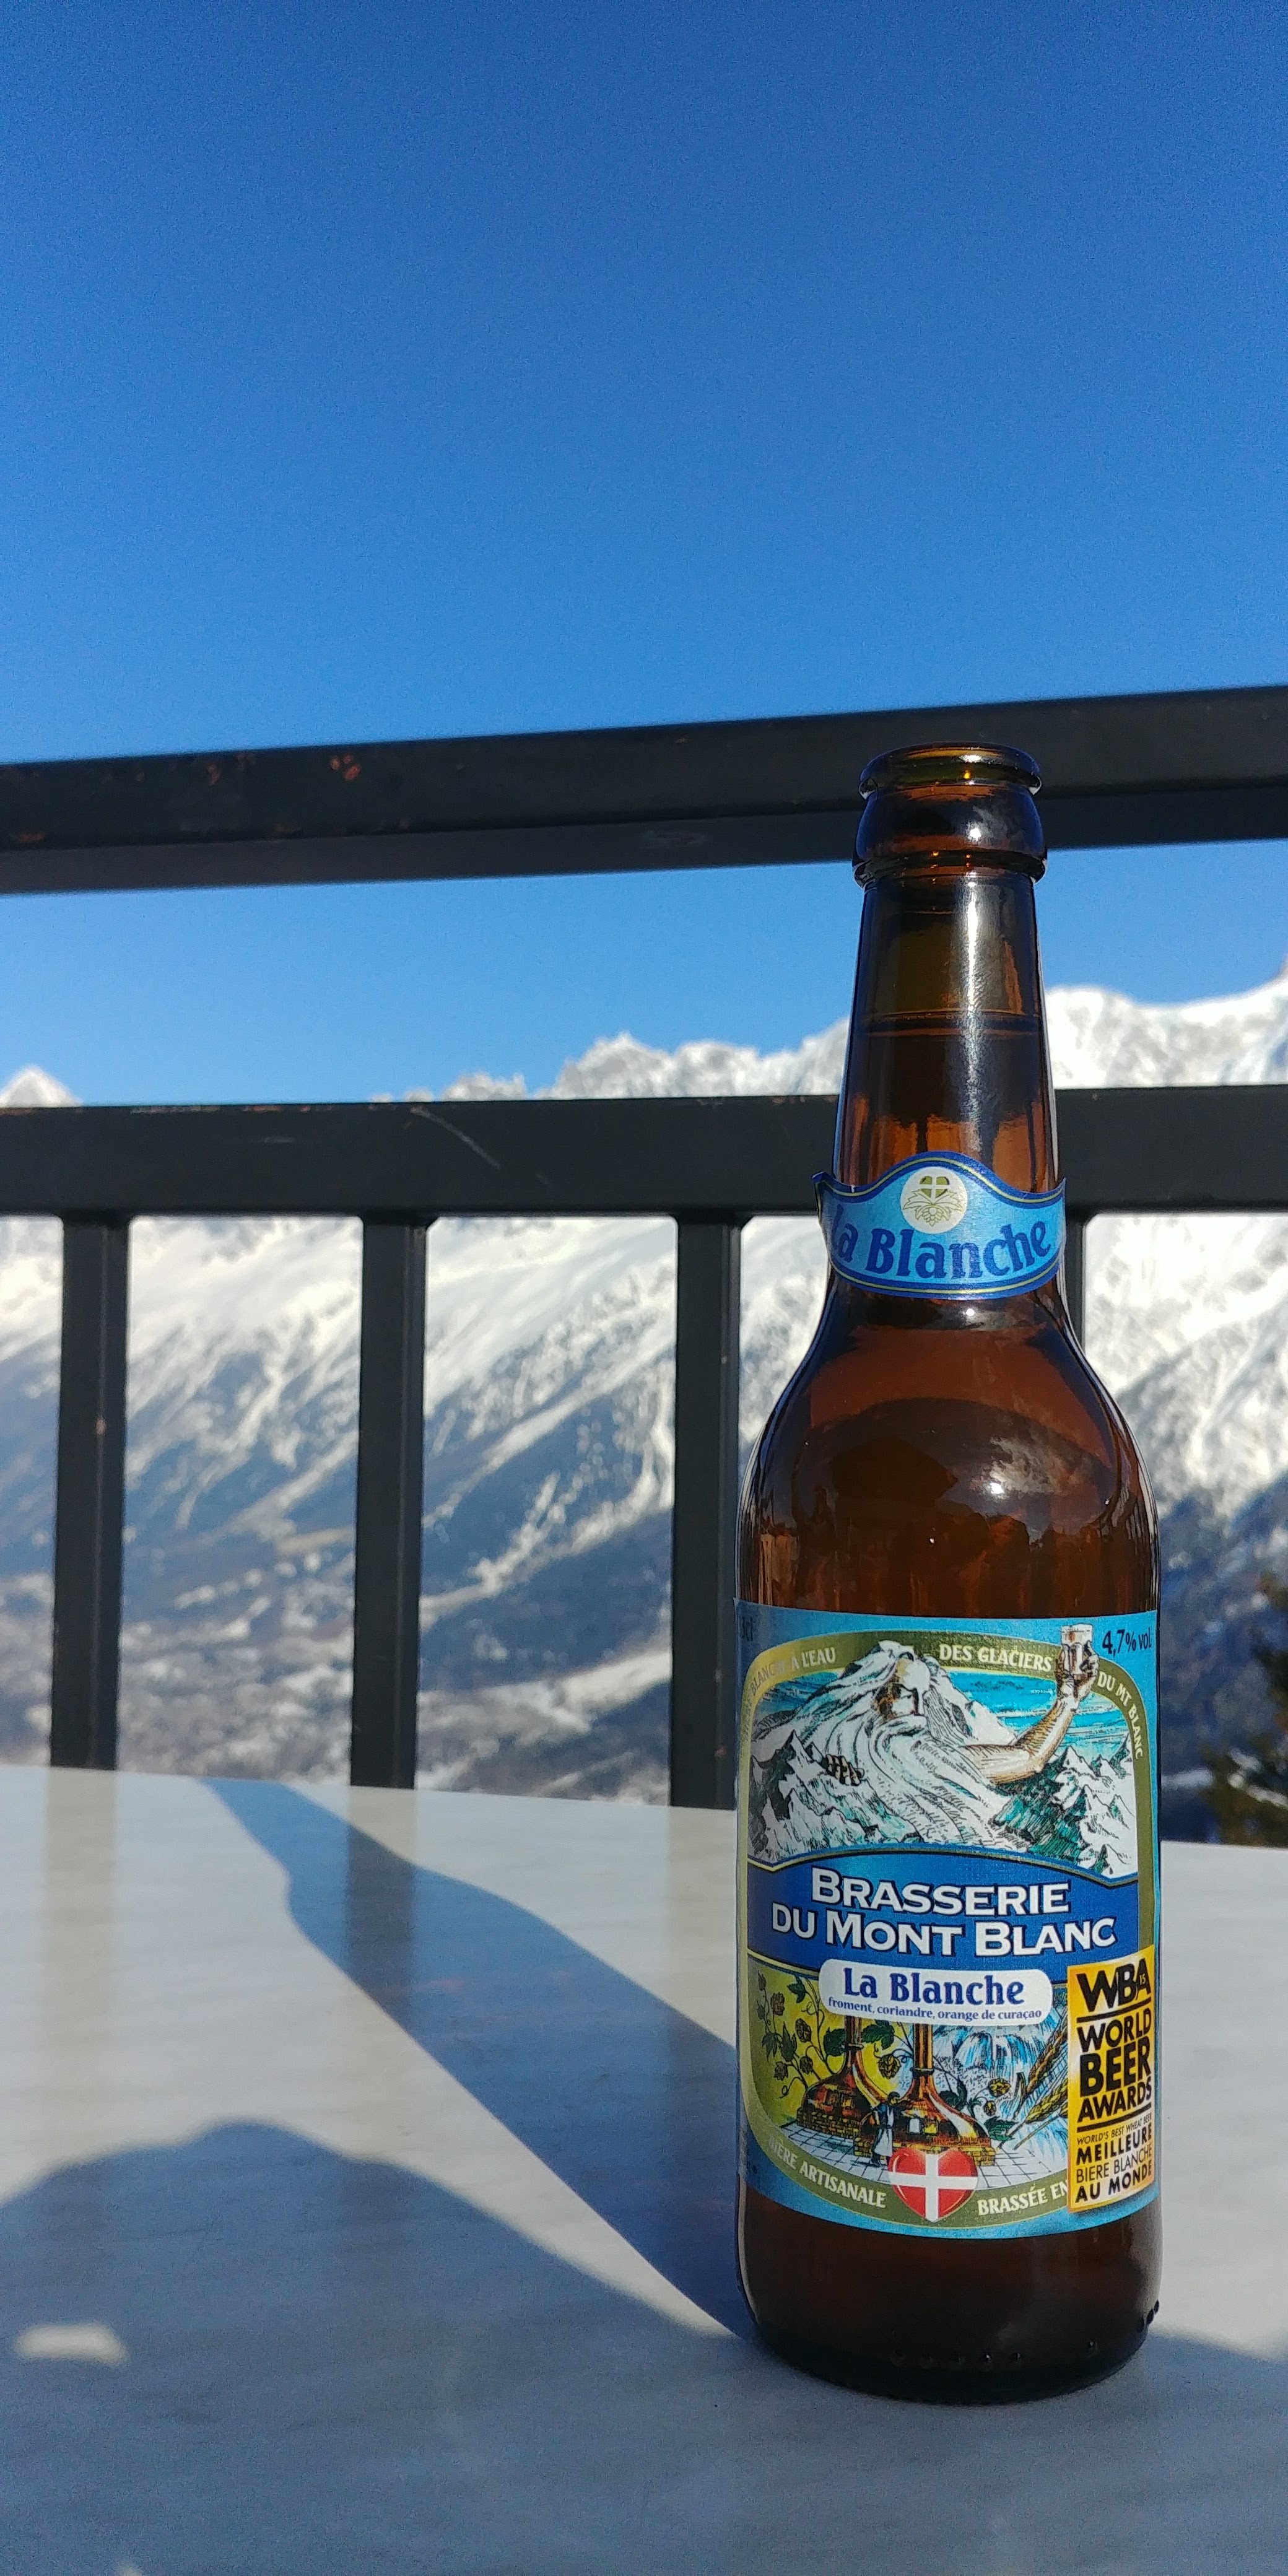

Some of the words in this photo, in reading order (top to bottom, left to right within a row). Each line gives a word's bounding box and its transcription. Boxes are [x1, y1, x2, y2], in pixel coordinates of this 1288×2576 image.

[865, 1221, 1051, 1280] Blanche
[1102, 1628, 1137, 1658] 4,7%
[750, 1659, 791, 1697] BLANC
[801, 1647, 836, 1668] L'EAU
[939, 1644, 973, 1661] DES
[977, 1647, 1053, 1673] GLACIERS
[1097, 1671, 1116, 1692] DU
[1115, 1682, 1132, 1707] MT
[1128, 1704, 1144, 1760] BLANC
[811, 1866, 1071, 1916] BRASSERIE
[772, 1902, 816, 1939] DU
[825, 1910, 964, 1957] MONT
[975, 1916, 1116, 1957] BLANC
[843, 1967, 877, 1999] La
[889, 1972, 1025, 2006] Blanche
[1076, 1957, 1151, 2013] WBA
[829, 1996, 875, 2014] froment,
[877, 2006, 936, 2019] coriandre,
[938, 2011, 979, 2022] orange
[981, 2009, 996, 2020] de
[998, 2010, 1042, 2021] curaçao
[1077, 2008, 1152, 2053] WORLD
[1079, 2035, 1151, 2098] BEER
[1077, 2077, 1152, 2123] AWARDS
[1076, 2122, 1152, 2165] MEILLEURE
[1077, 2131, 1109, 2146] WORLD'S
[1112, 2126, 1125, 2137] BEST
[1126, 2117, 1143, 2133] WHEAT
[1075, 2182, 1100, 2203] AU
[1108, 2159, 1152, 2196] MONDE
[1076, 2162, 1110, 2183] BIERE
[1113, 2143, 1152, 2175] BLANCHE
[799, 2160, 886, 2209] ARTISANALE
[977, 2183, 1048, 2216] BRASSÉE
